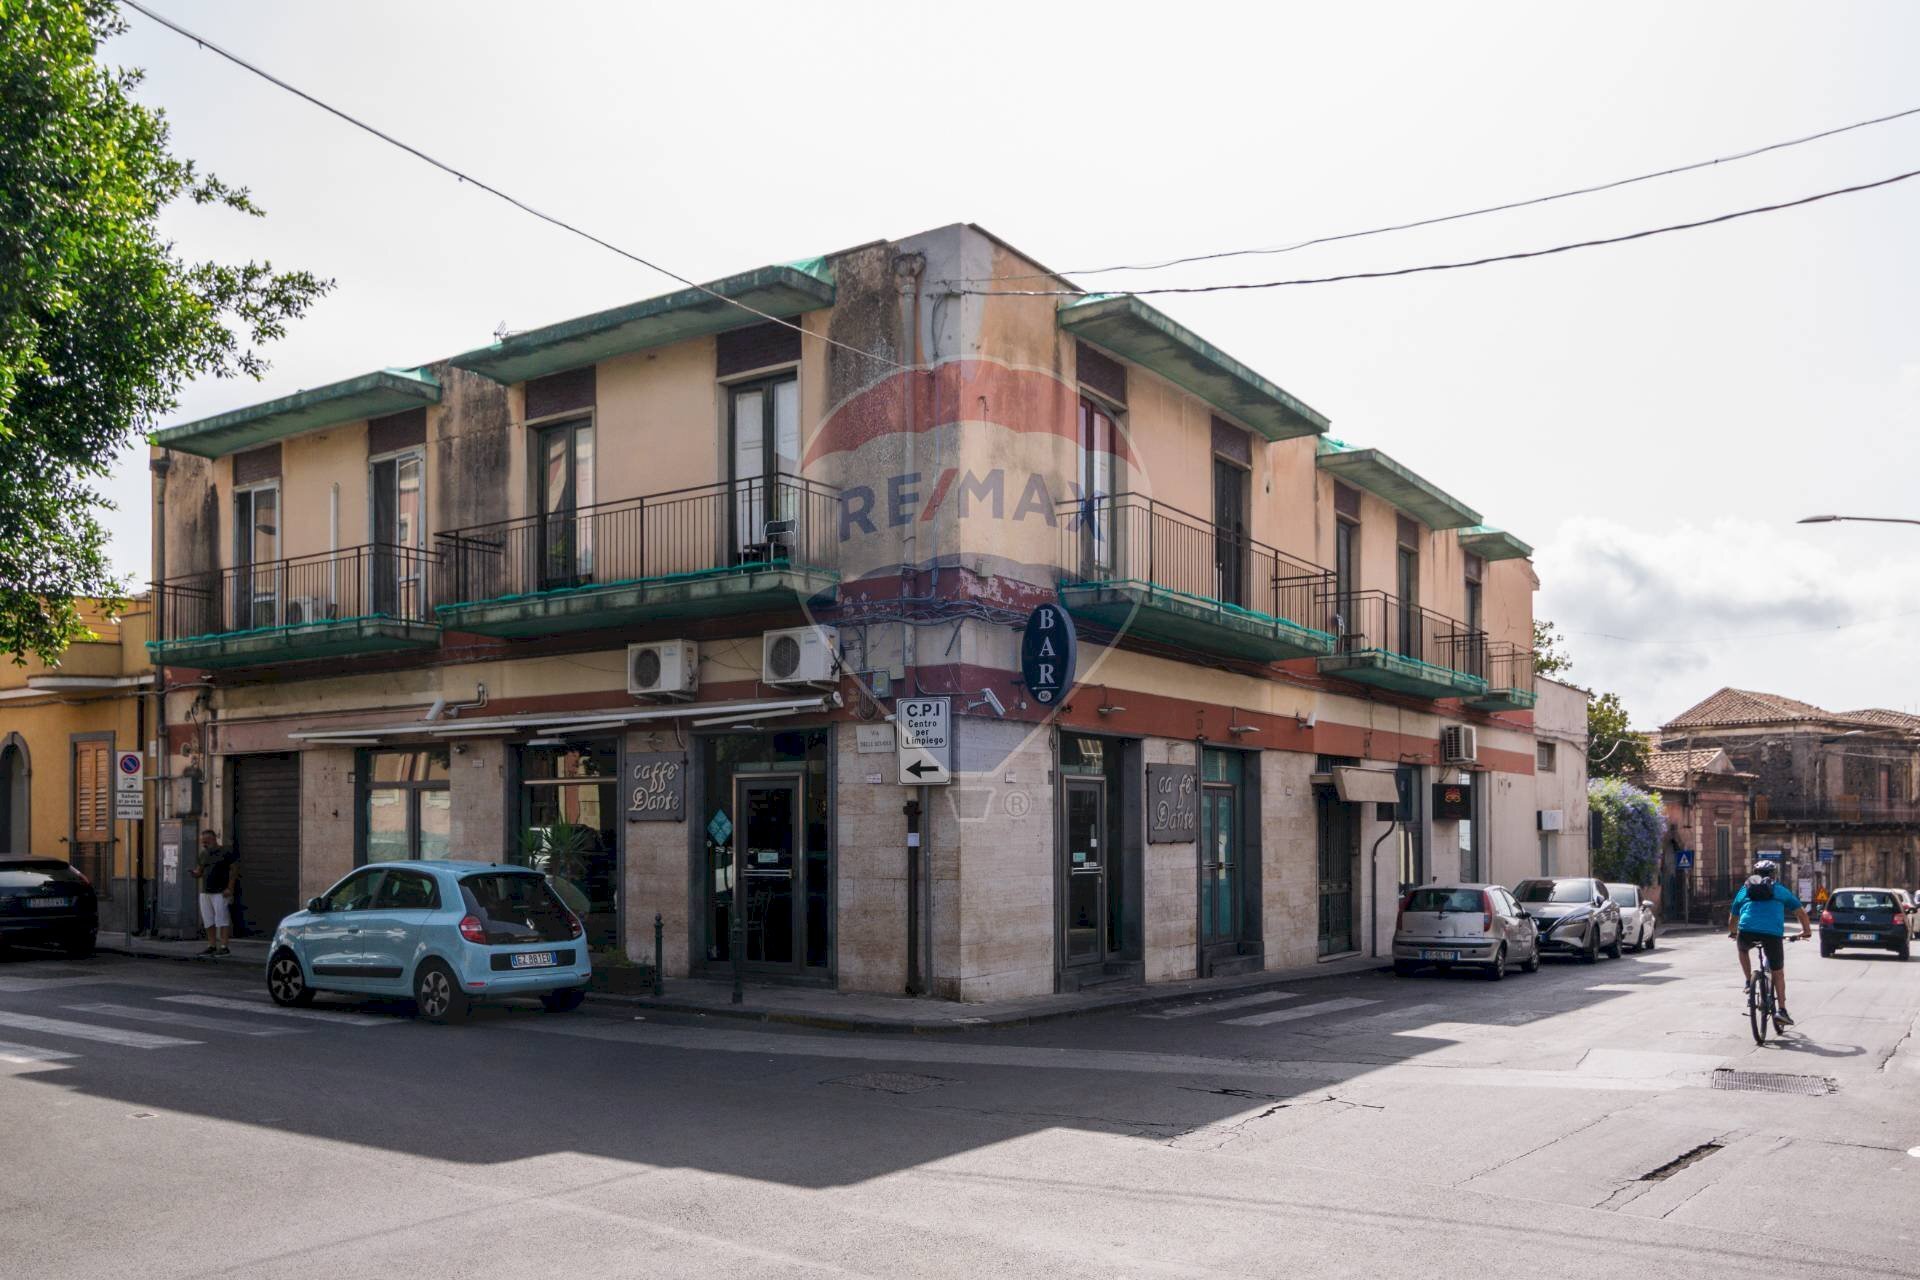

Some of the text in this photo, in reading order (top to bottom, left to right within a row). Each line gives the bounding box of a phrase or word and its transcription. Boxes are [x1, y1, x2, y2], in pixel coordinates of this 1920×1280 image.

[1038, 608, 1056, 684] BAR
[908, 719, 937, 728] Centro
[915, 729, 929, 737] per
[628, 786, 680, 811] Dante
[1154, 799, 1194, 830] Dante
